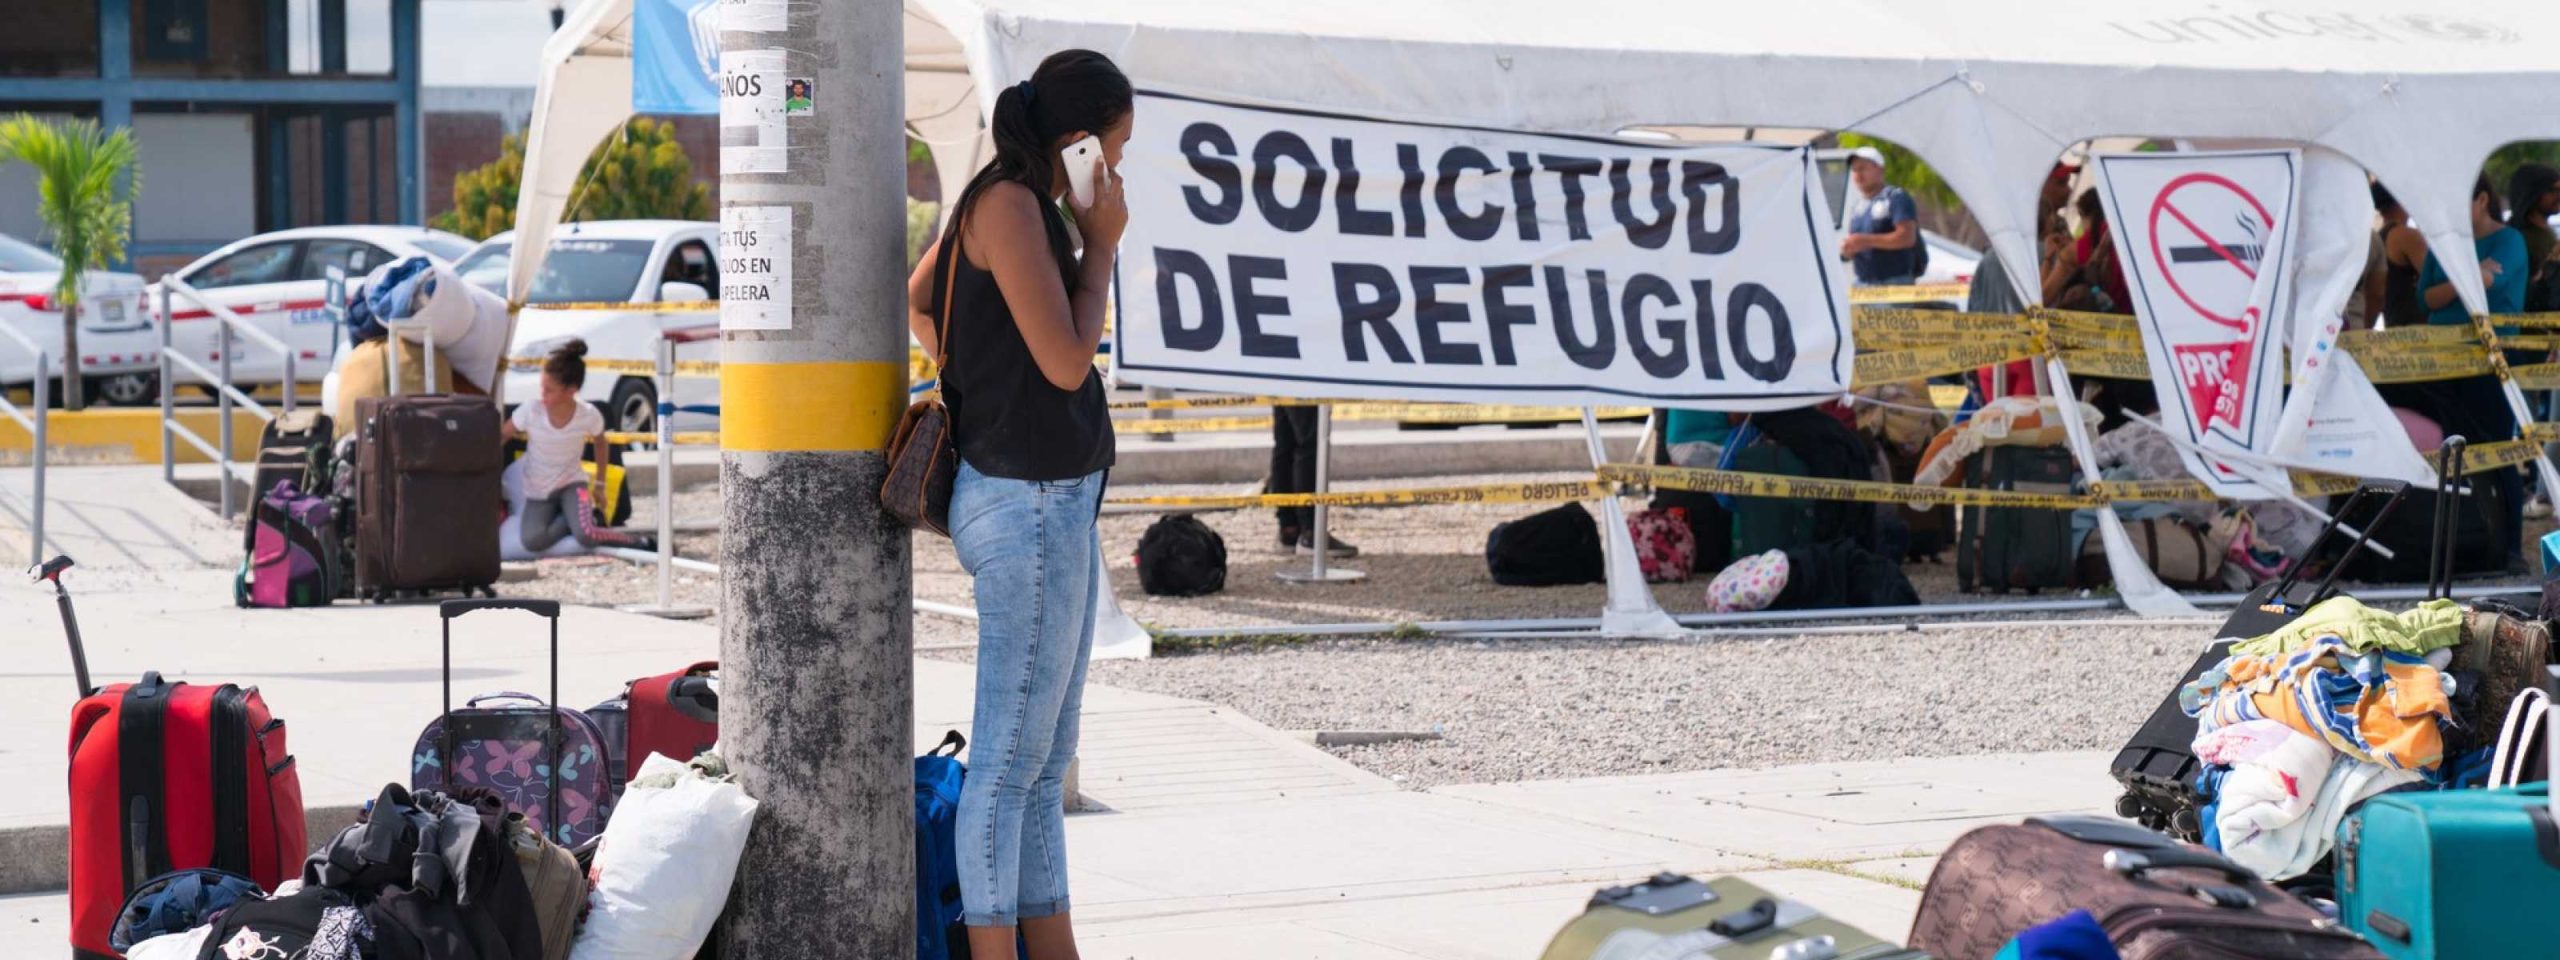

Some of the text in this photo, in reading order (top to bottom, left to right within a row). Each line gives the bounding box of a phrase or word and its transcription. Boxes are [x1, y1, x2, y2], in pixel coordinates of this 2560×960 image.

[1178, 121, 1741, 255] SOLICITUD
[733, 230, 757, 247] TUS
[751, 258, 771, 273] EN
[1153, 246, 1797, 384] DE REFUGIO
[1521, 481, 1590, 500] PELIGRO
